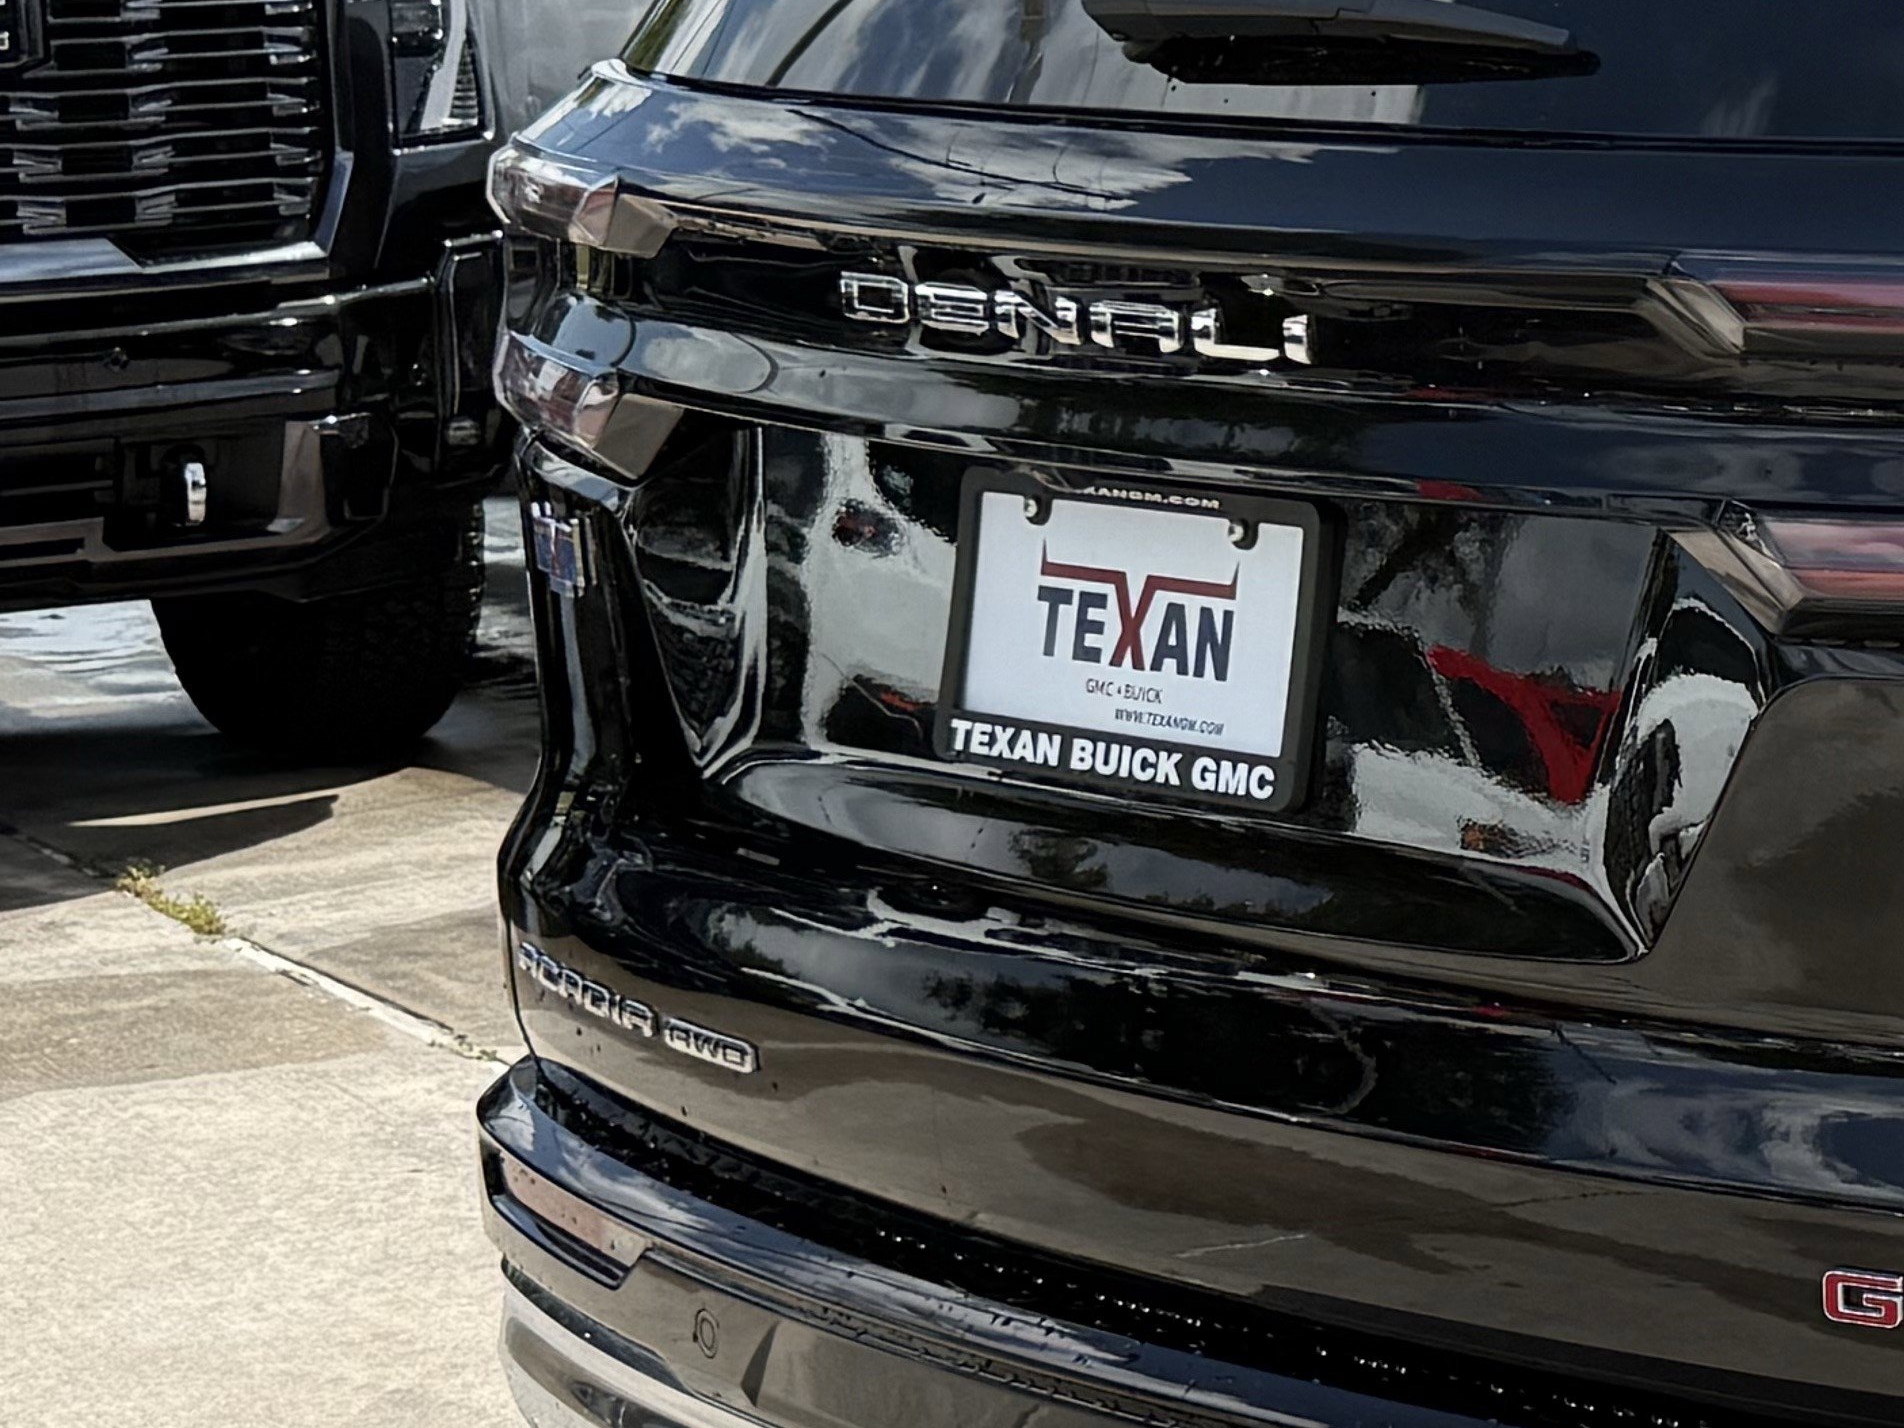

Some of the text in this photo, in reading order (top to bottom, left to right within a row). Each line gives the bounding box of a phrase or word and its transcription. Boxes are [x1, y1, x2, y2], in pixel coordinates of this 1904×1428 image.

[840, 270, 1315, 365] DENALI
[1036, 540, 1241, 683] TEXAN
[1085, 677, 1164, 705] GMC BUICK
[950, 717, 1276, 800] TEXAN BUICK GMC
[519, 941, 758, 1073] ACADIA AWD
